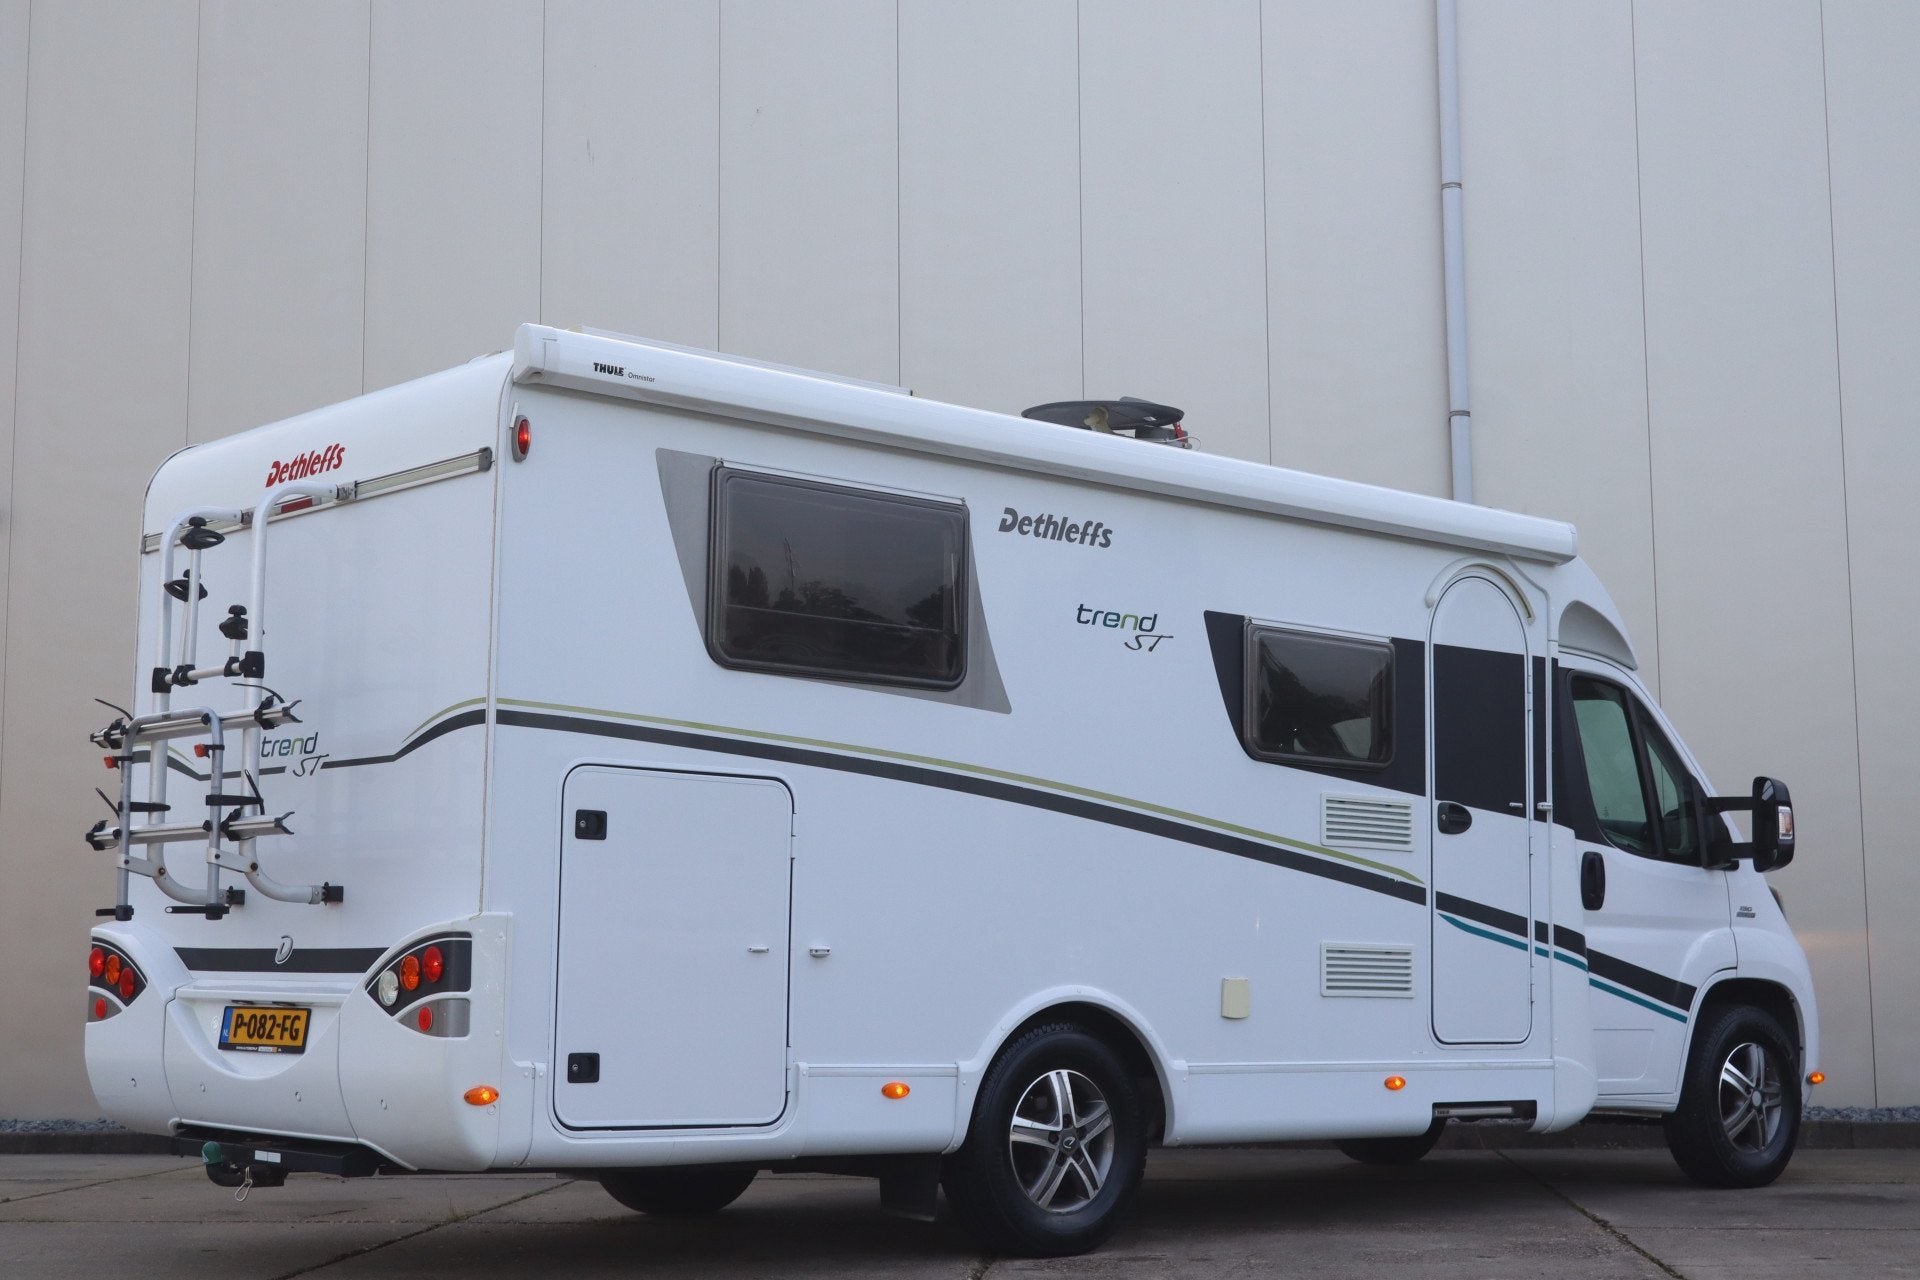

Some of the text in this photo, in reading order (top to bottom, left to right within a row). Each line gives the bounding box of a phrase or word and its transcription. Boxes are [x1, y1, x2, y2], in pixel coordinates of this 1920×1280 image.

[593, 362, 624, 376] THULE
[265, 443, 345, 488] Dethleffs
[998, 507, 1113, 548] Dethleffs
[1076, 603, 1158, 632] trend
[1124, 634, 1174, 652] ST
[261, 731, 318, 757] trend
[292, 753, 329, 777] ST
[233, 1013, 301, 1041] P-082-FG
